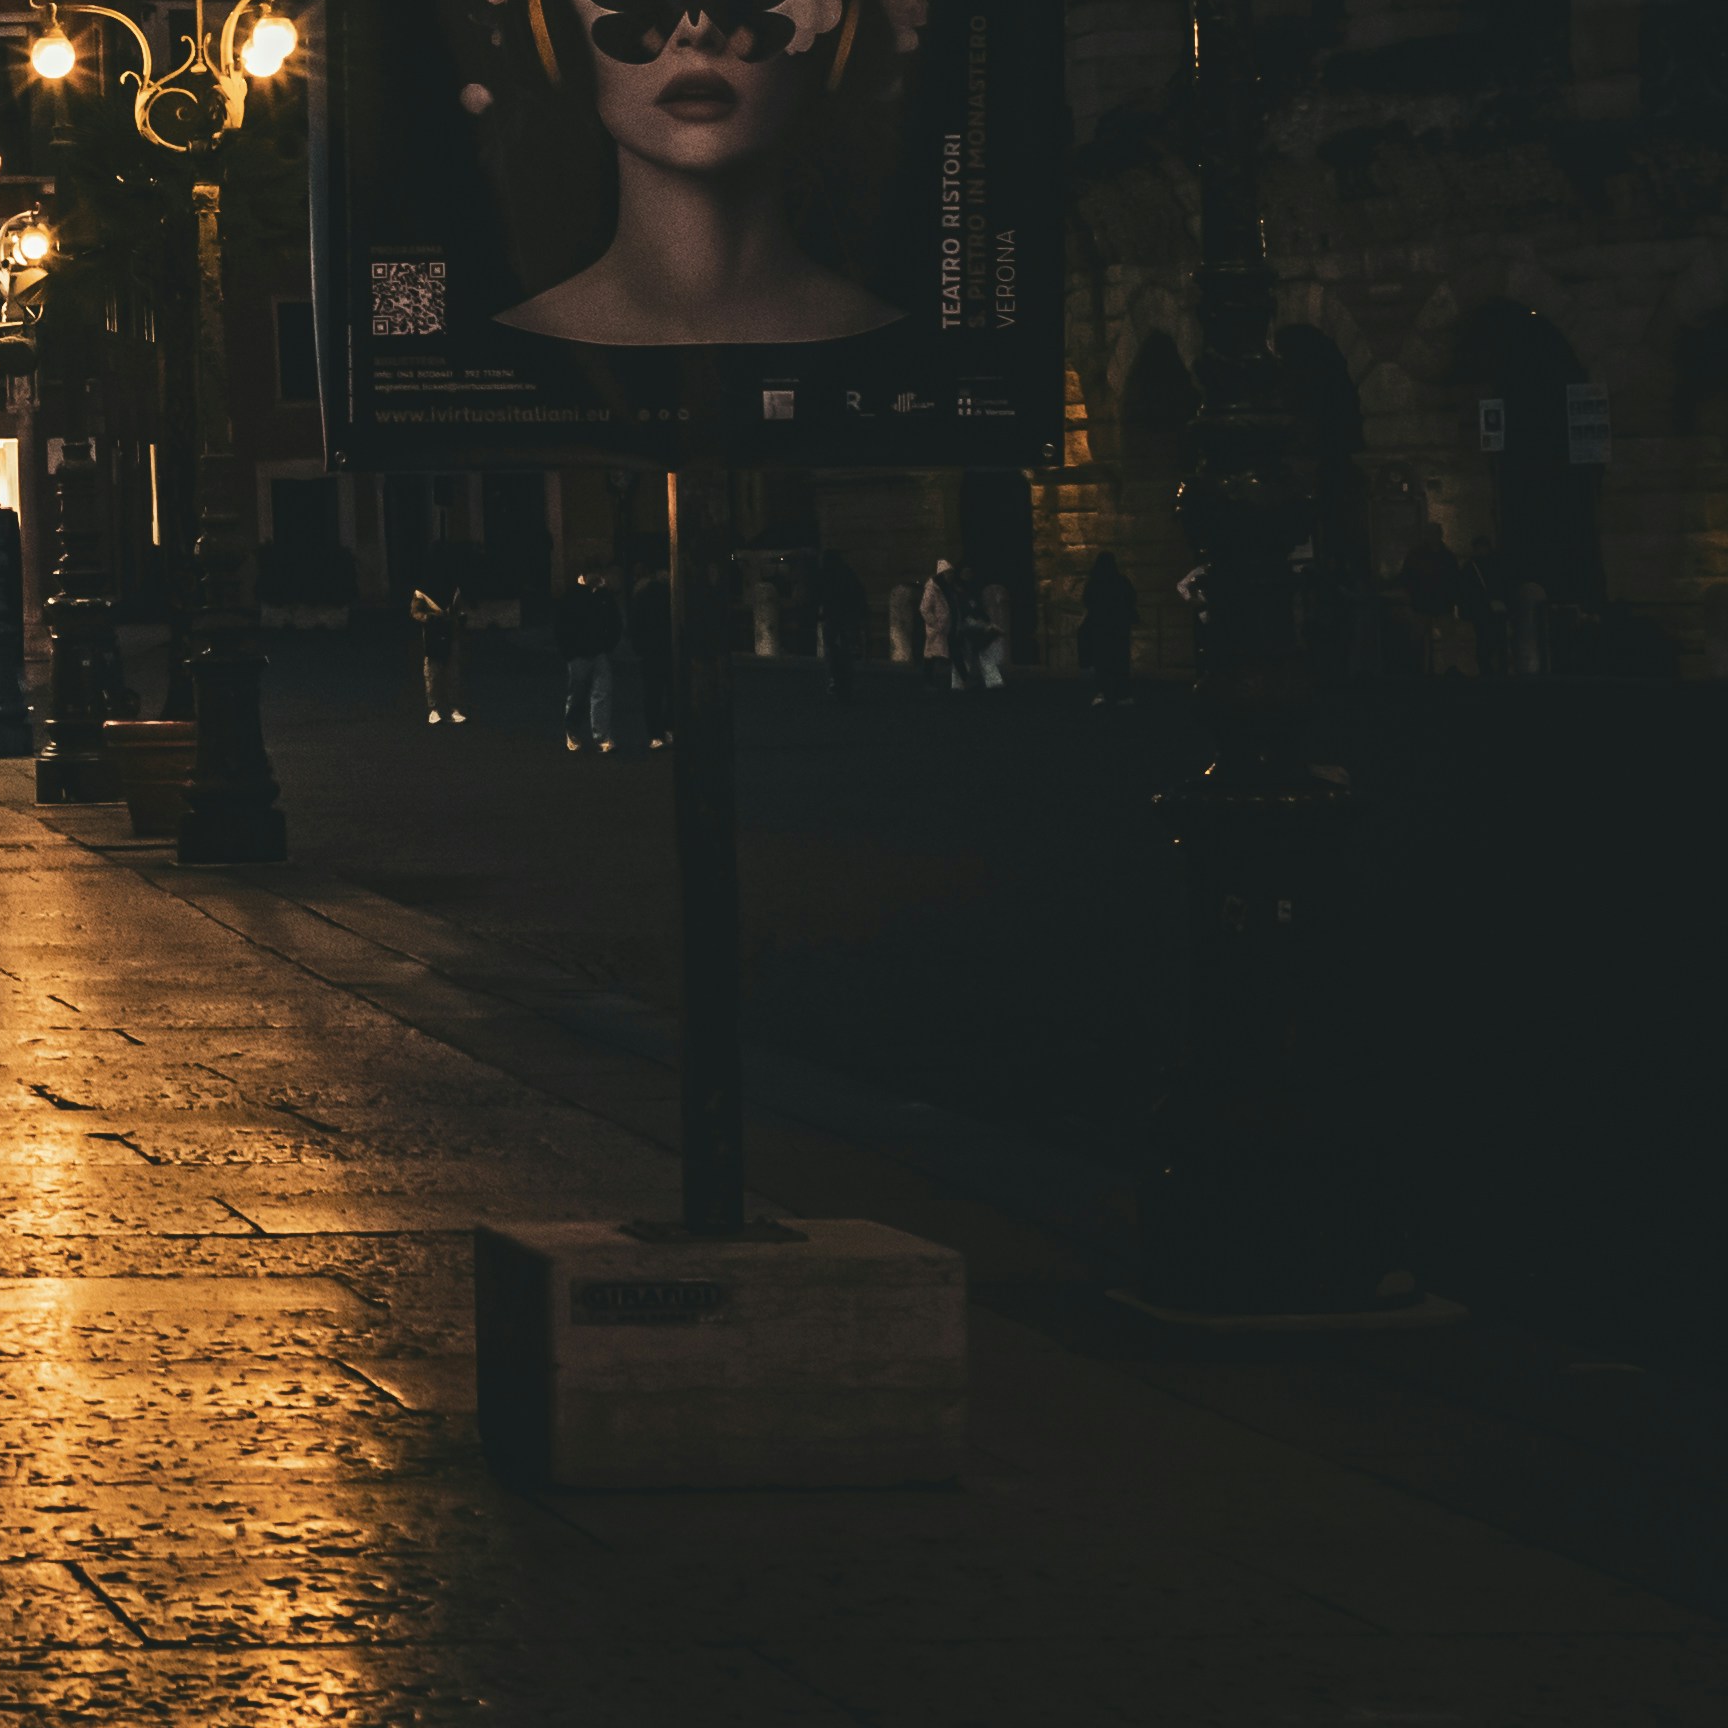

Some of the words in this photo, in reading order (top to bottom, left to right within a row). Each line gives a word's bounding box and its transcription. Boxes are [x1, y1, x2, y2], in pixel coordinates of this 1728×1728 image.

[967, 15, 988, 170] MONASTERO
[941, 133, 962, 229] RISTORI
[967, 178, 987, 204] IN
[941, 237, 962, 330] TEATRO
[967, 213, 987, 301] PIETRO
[995, 229, 1017, 329] VERONA
[375, 404, 611, 425] www.ivirtuositaliani.eu
